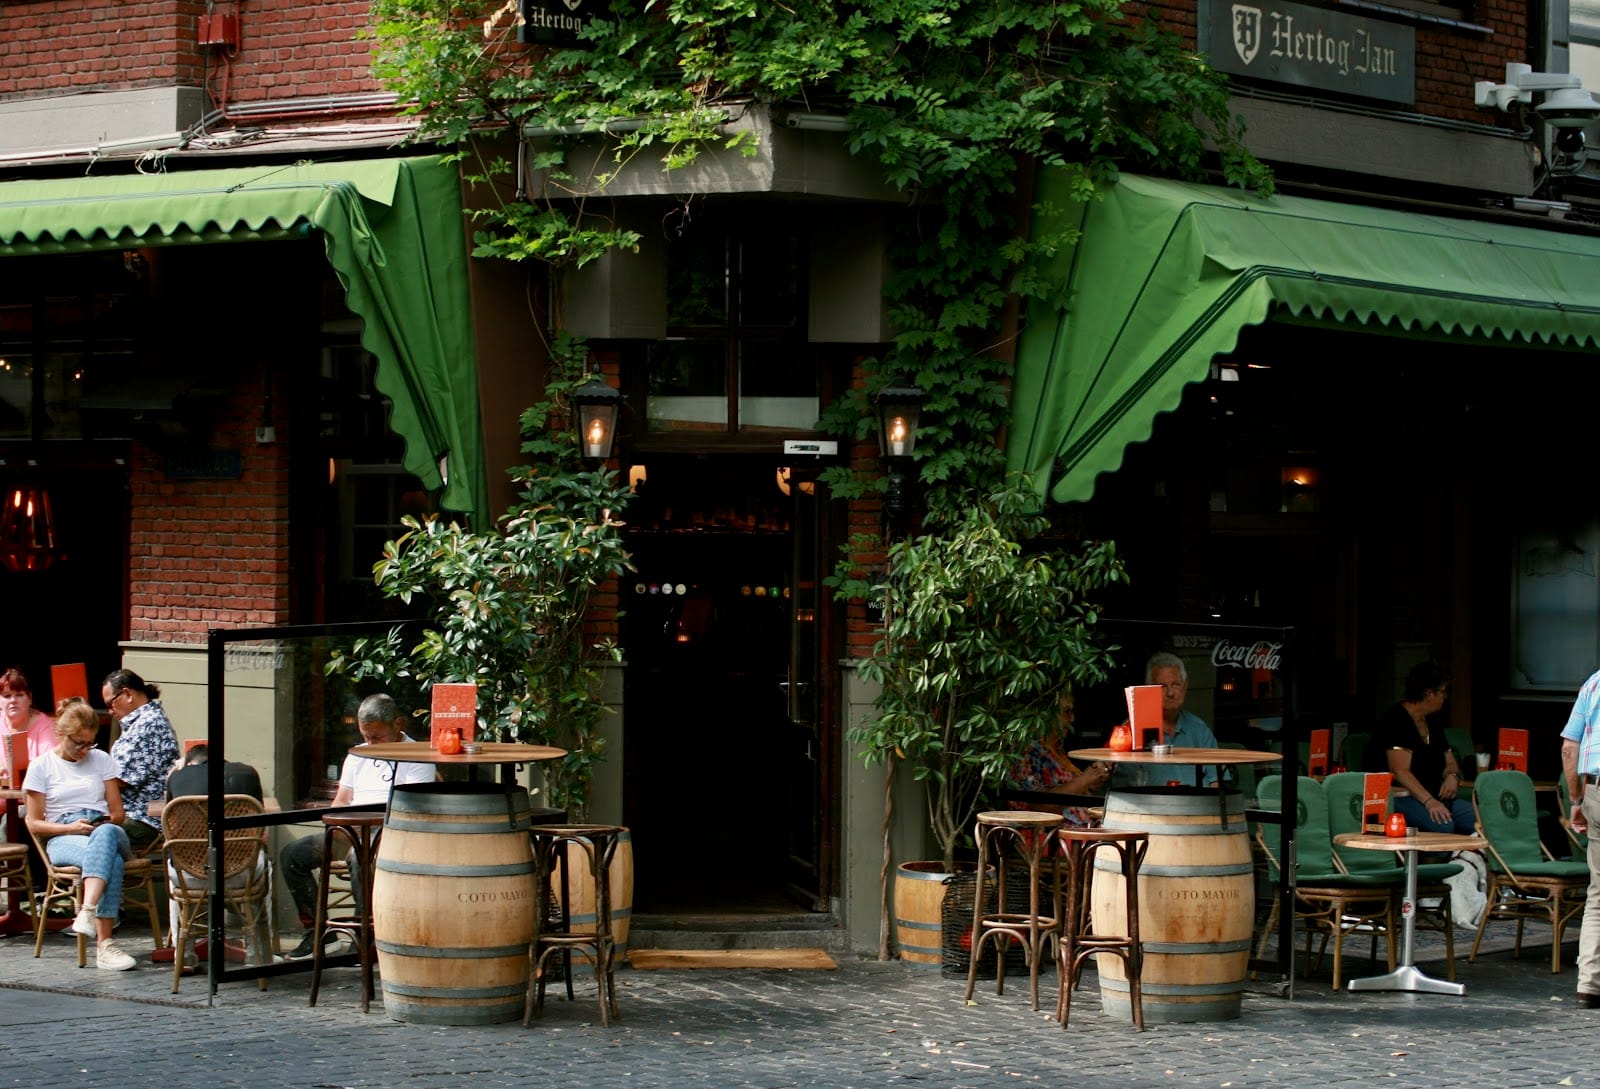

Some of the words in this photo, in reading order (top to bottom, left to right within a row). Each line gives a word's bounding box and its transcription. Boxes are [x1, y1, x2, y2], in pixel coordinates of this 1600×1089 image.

[531, 5, 583, 35] Hertog
[1270, 11, 1350, 76] Hertog
[1354, 29, 1396, 76] Jan
[457, 891, 497, 904] COTO
